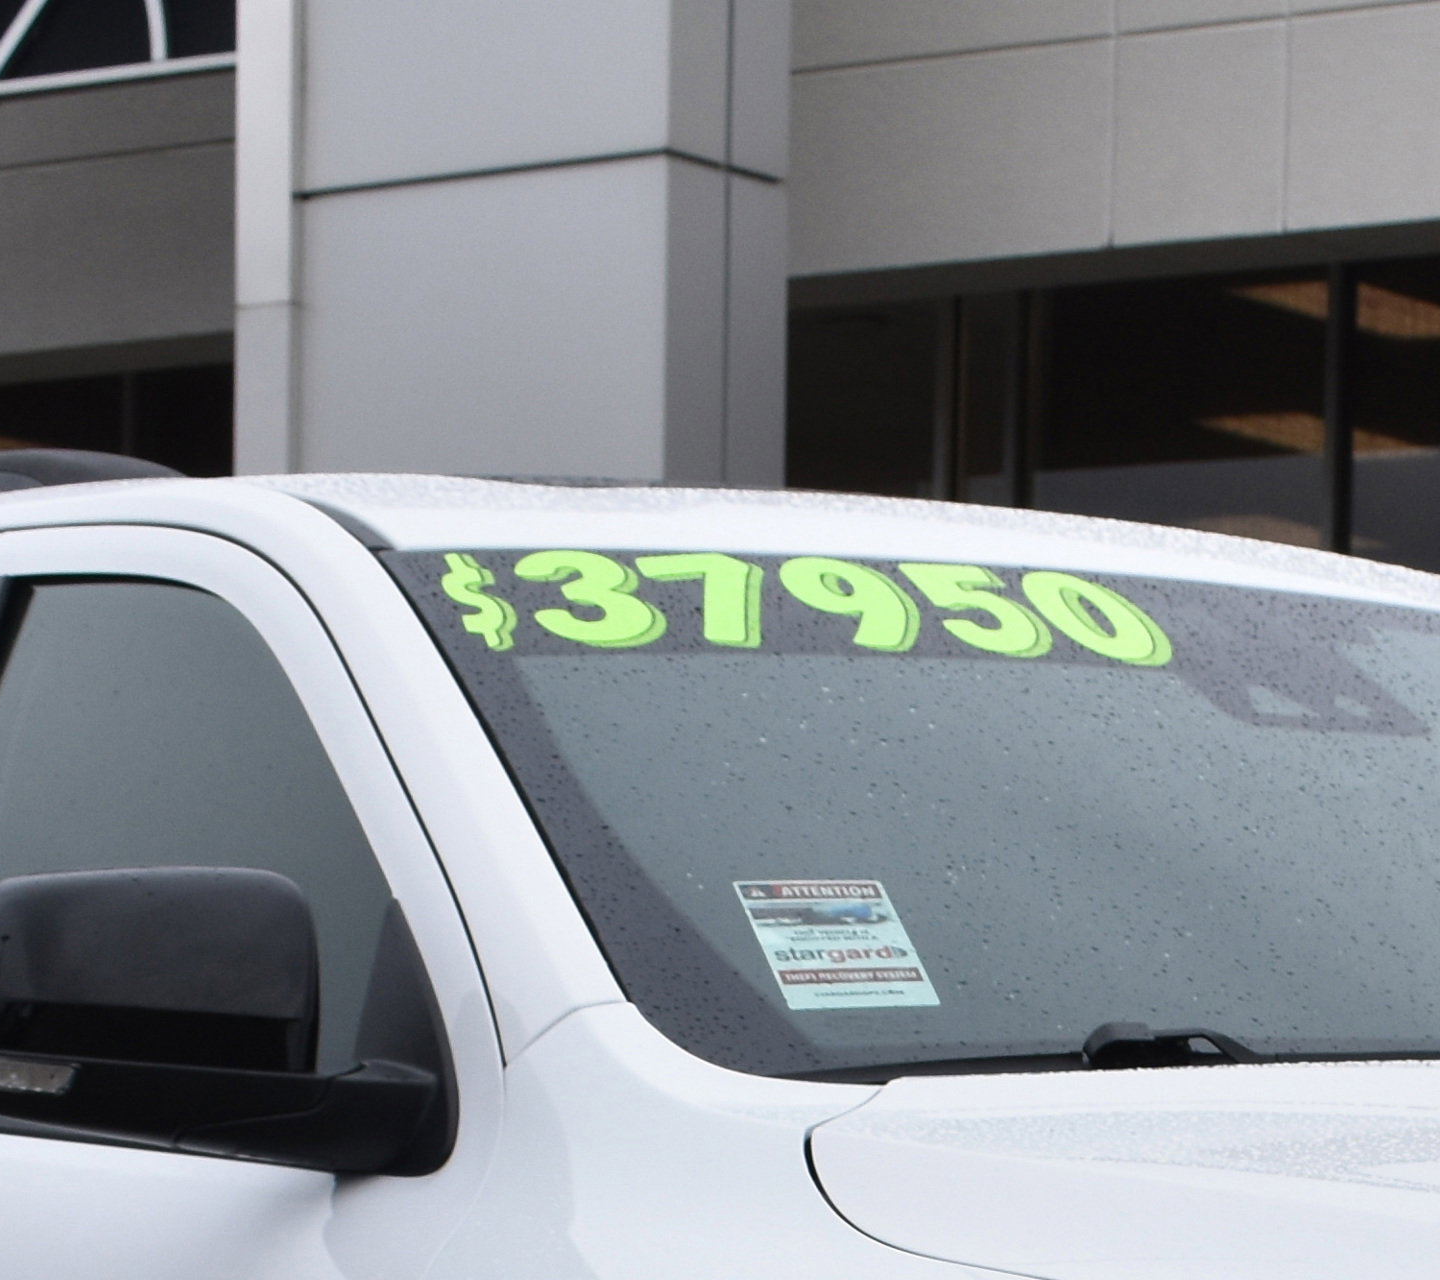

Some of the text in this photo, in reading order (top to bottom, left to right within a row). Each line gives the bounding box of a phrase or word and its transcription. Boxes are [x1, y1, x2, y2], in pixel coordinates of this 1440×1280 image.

[440, 549, 1173, 667] $37950
[781, 884, 876, 898] ATTENTION
[774, 945, 893, 963] stargard
